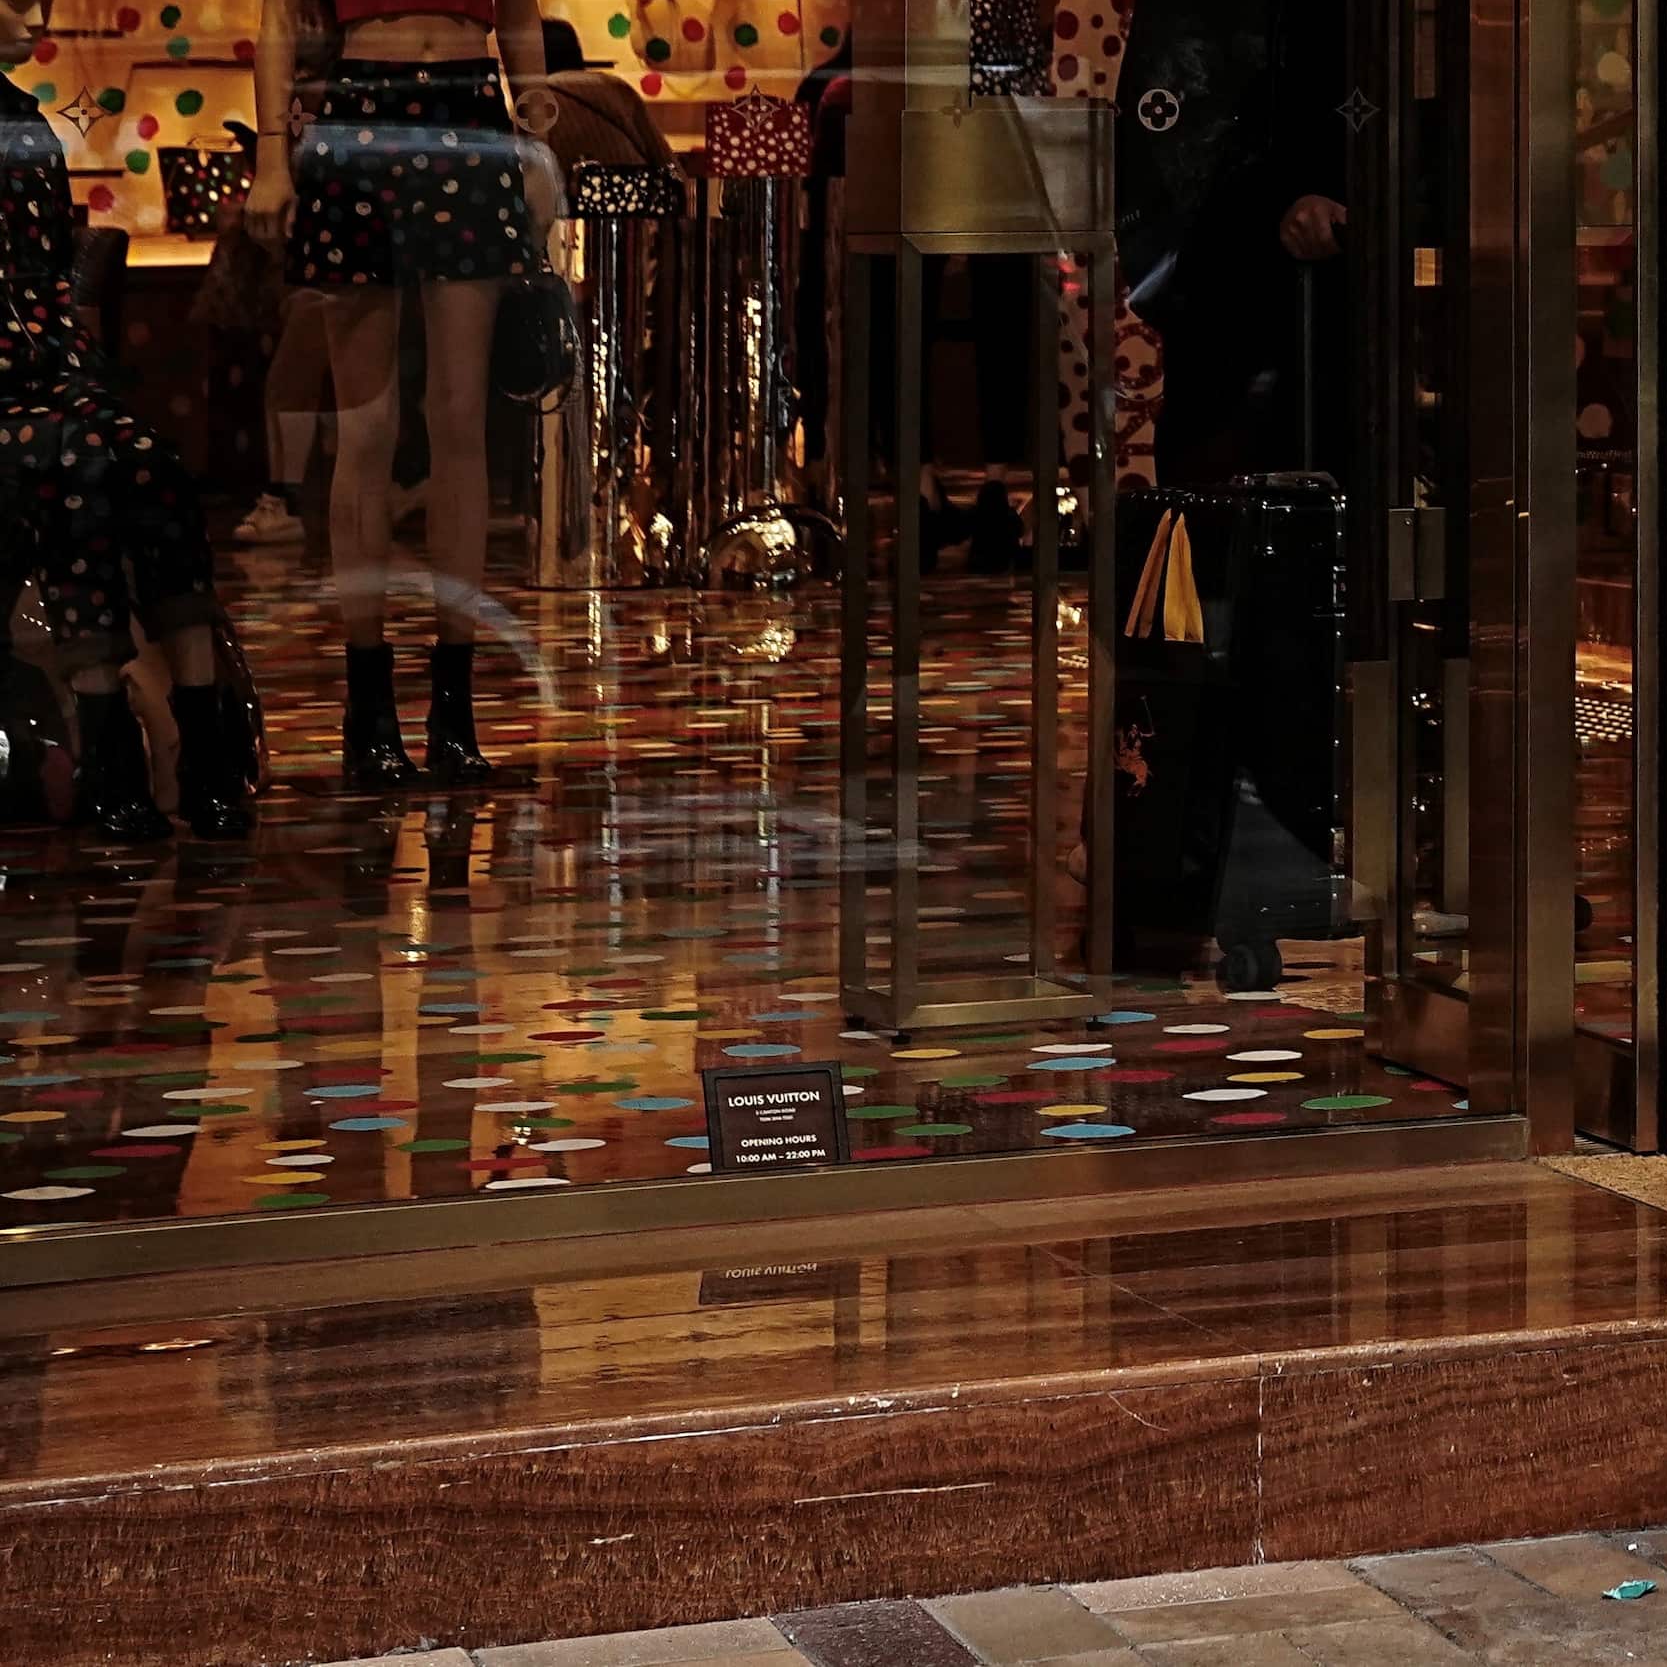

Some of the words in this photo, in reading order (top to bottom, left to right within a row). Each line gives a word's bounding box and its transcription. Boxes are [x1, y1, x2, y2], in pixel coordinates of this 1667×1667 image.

[728, 1095, 764, 1107] LOUIS
[766, 1091, 820, 1104] VUITTON
[741, 1137, 784, 1147] OPENING
[785, 1134, 817, 1144] HOURS
[736, 1154, 760, 1163] 10:00
[761, 1153, 777, 1161] AM
[786, 1150, 811, 1160] 22:00
